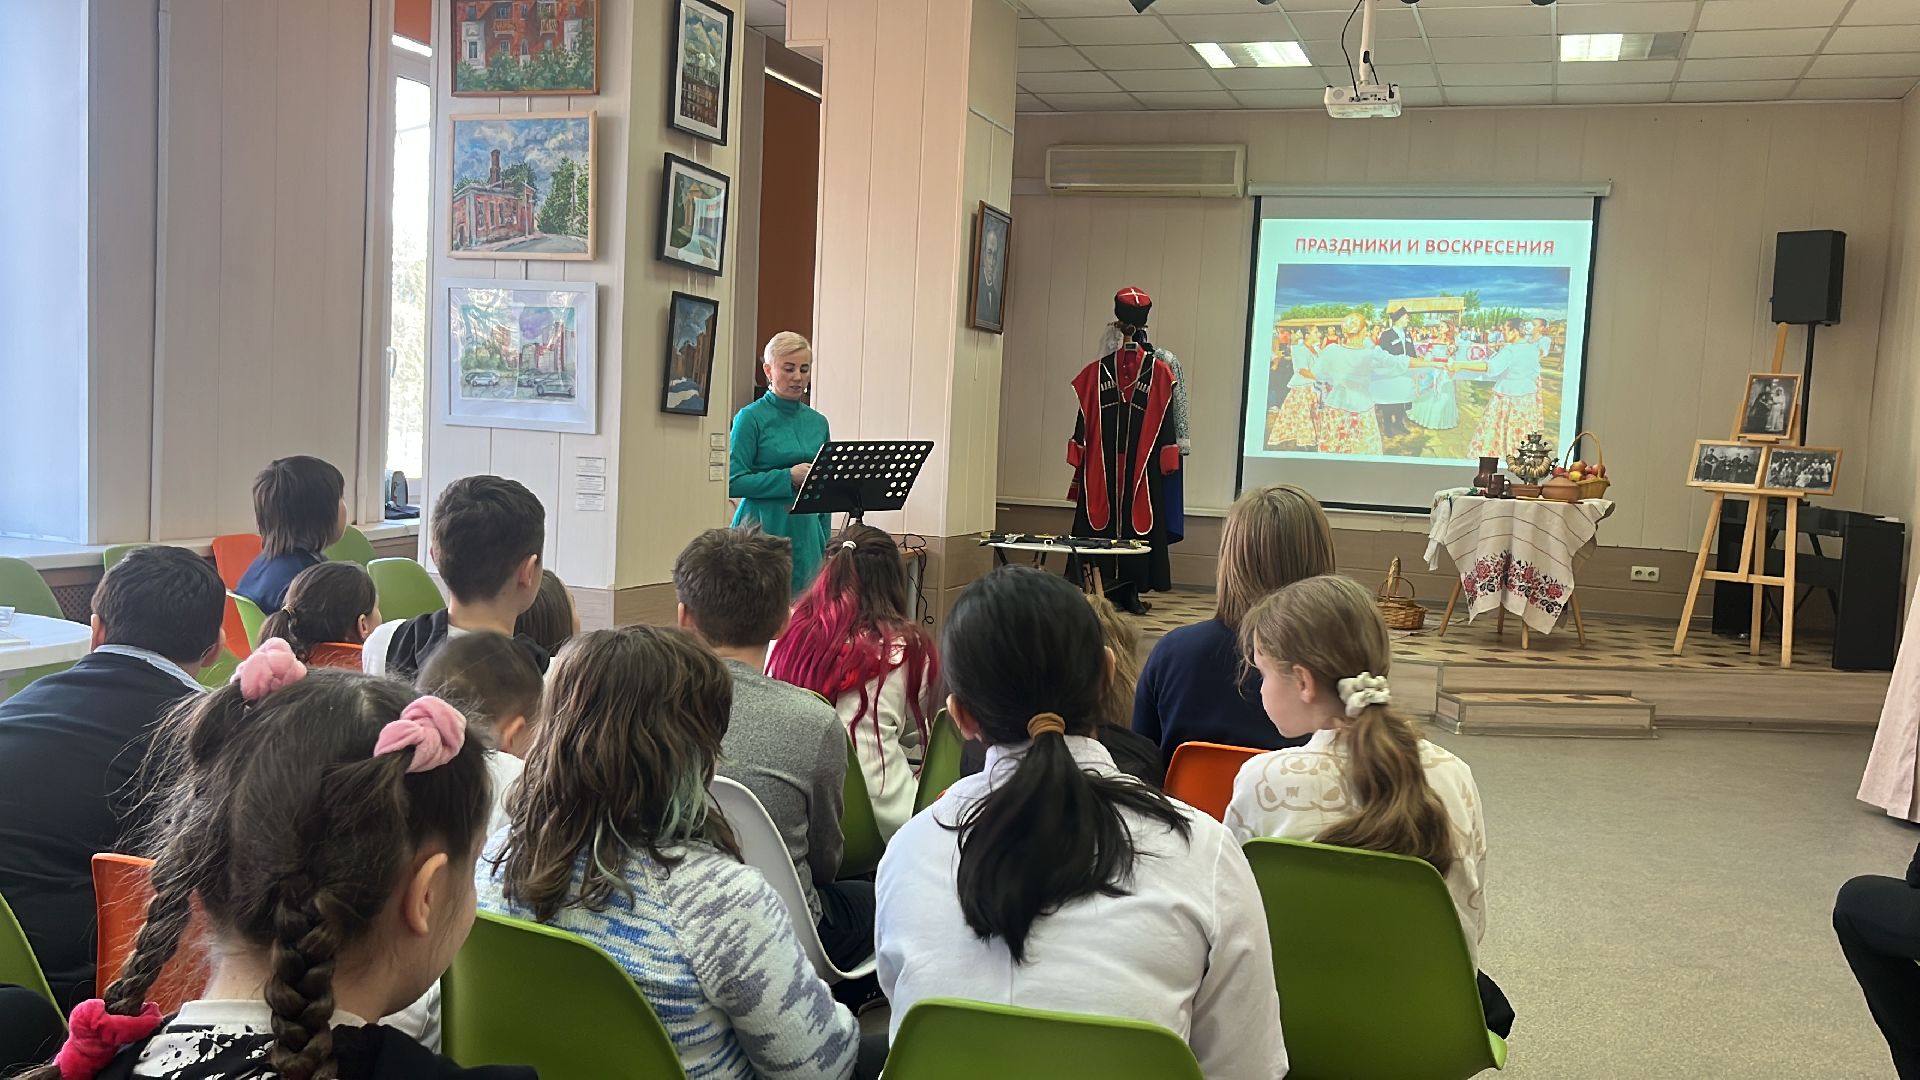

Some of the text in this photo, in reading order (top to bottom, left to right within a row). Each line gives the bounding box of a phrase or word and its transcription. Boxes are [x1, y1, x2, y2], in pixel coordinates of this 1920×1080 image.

[1295, 238, 1555, 256] ПРАЗДНИКИ И ВОСКРЕСЕНИЯ
